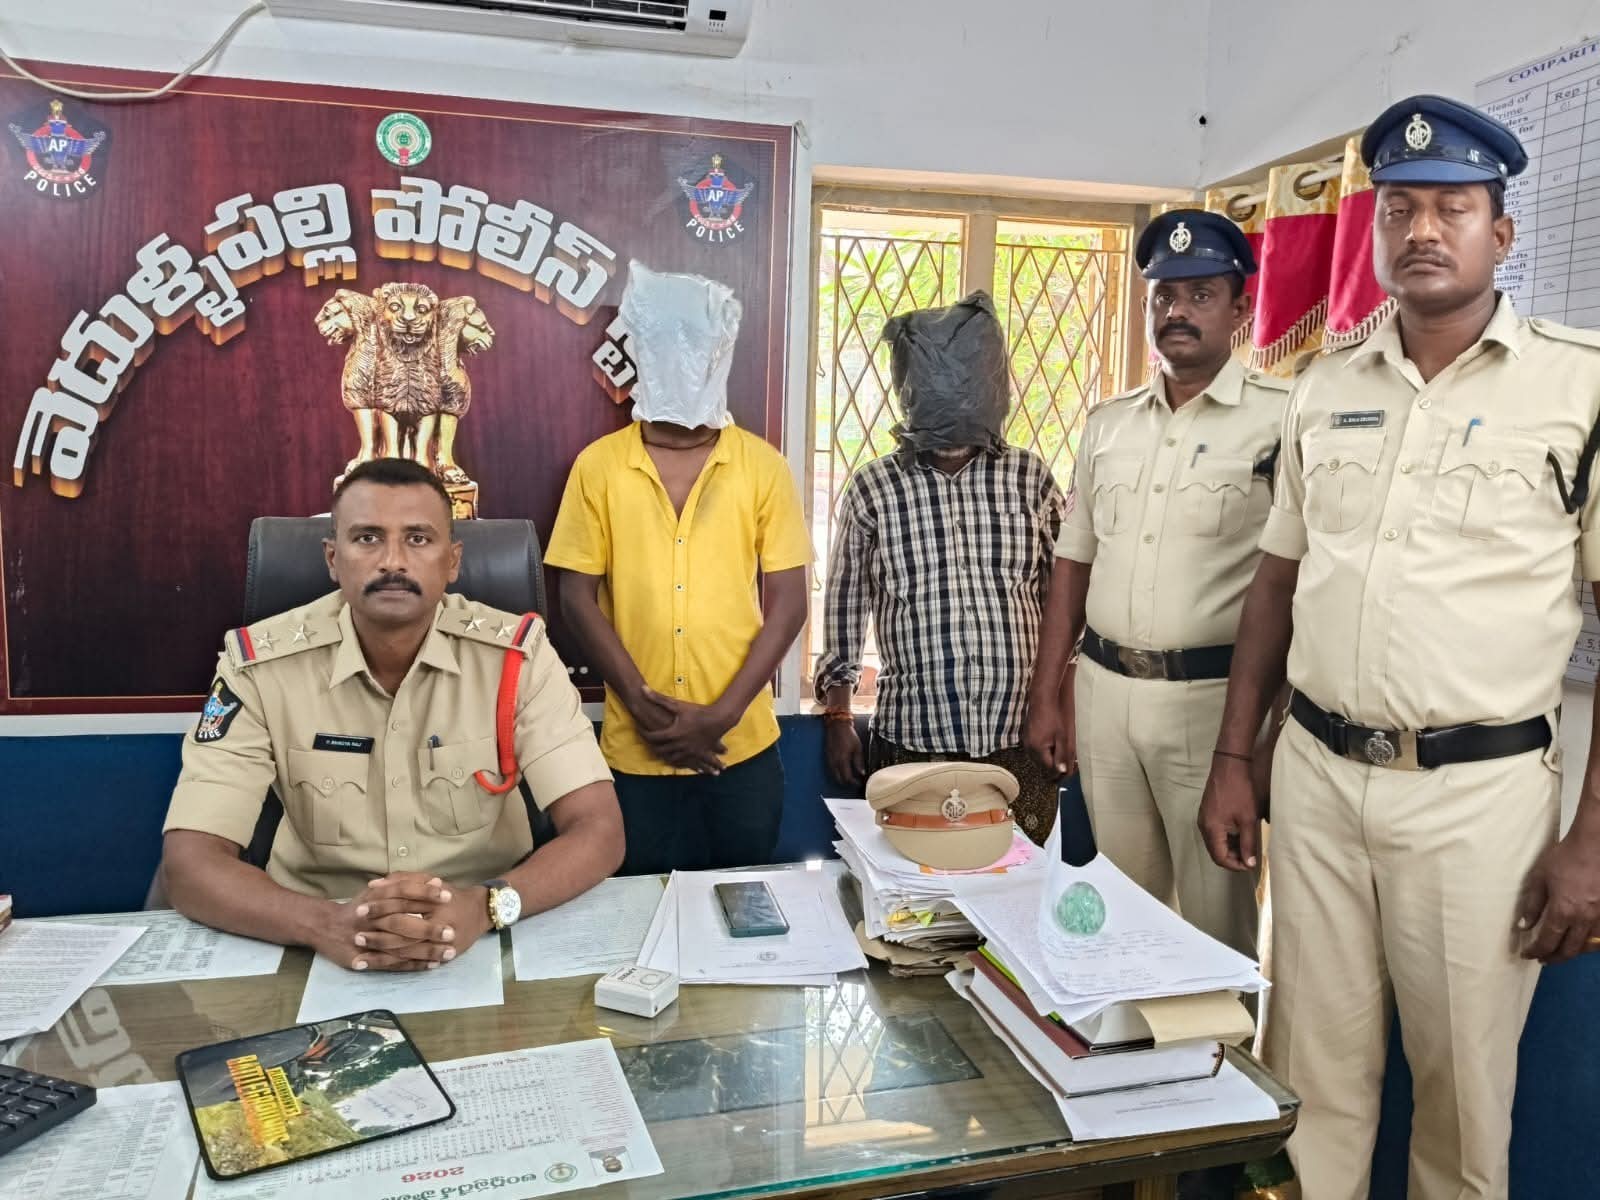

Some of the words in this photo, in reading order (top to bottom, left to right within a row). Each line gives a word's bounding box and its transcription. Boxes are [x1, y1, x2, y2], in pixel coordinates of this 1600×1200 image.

[48, 138, 68, 152] AP
[24, 170, 96, 197] POLICE
[708, 189, 724, 202] AP
[686, 218, 744, 242] POLICE
[371, 175, 616, 318] పోలీస్
[198, 728, 221, 739] LICE
[401, 1166, 464, 1183] 2026
